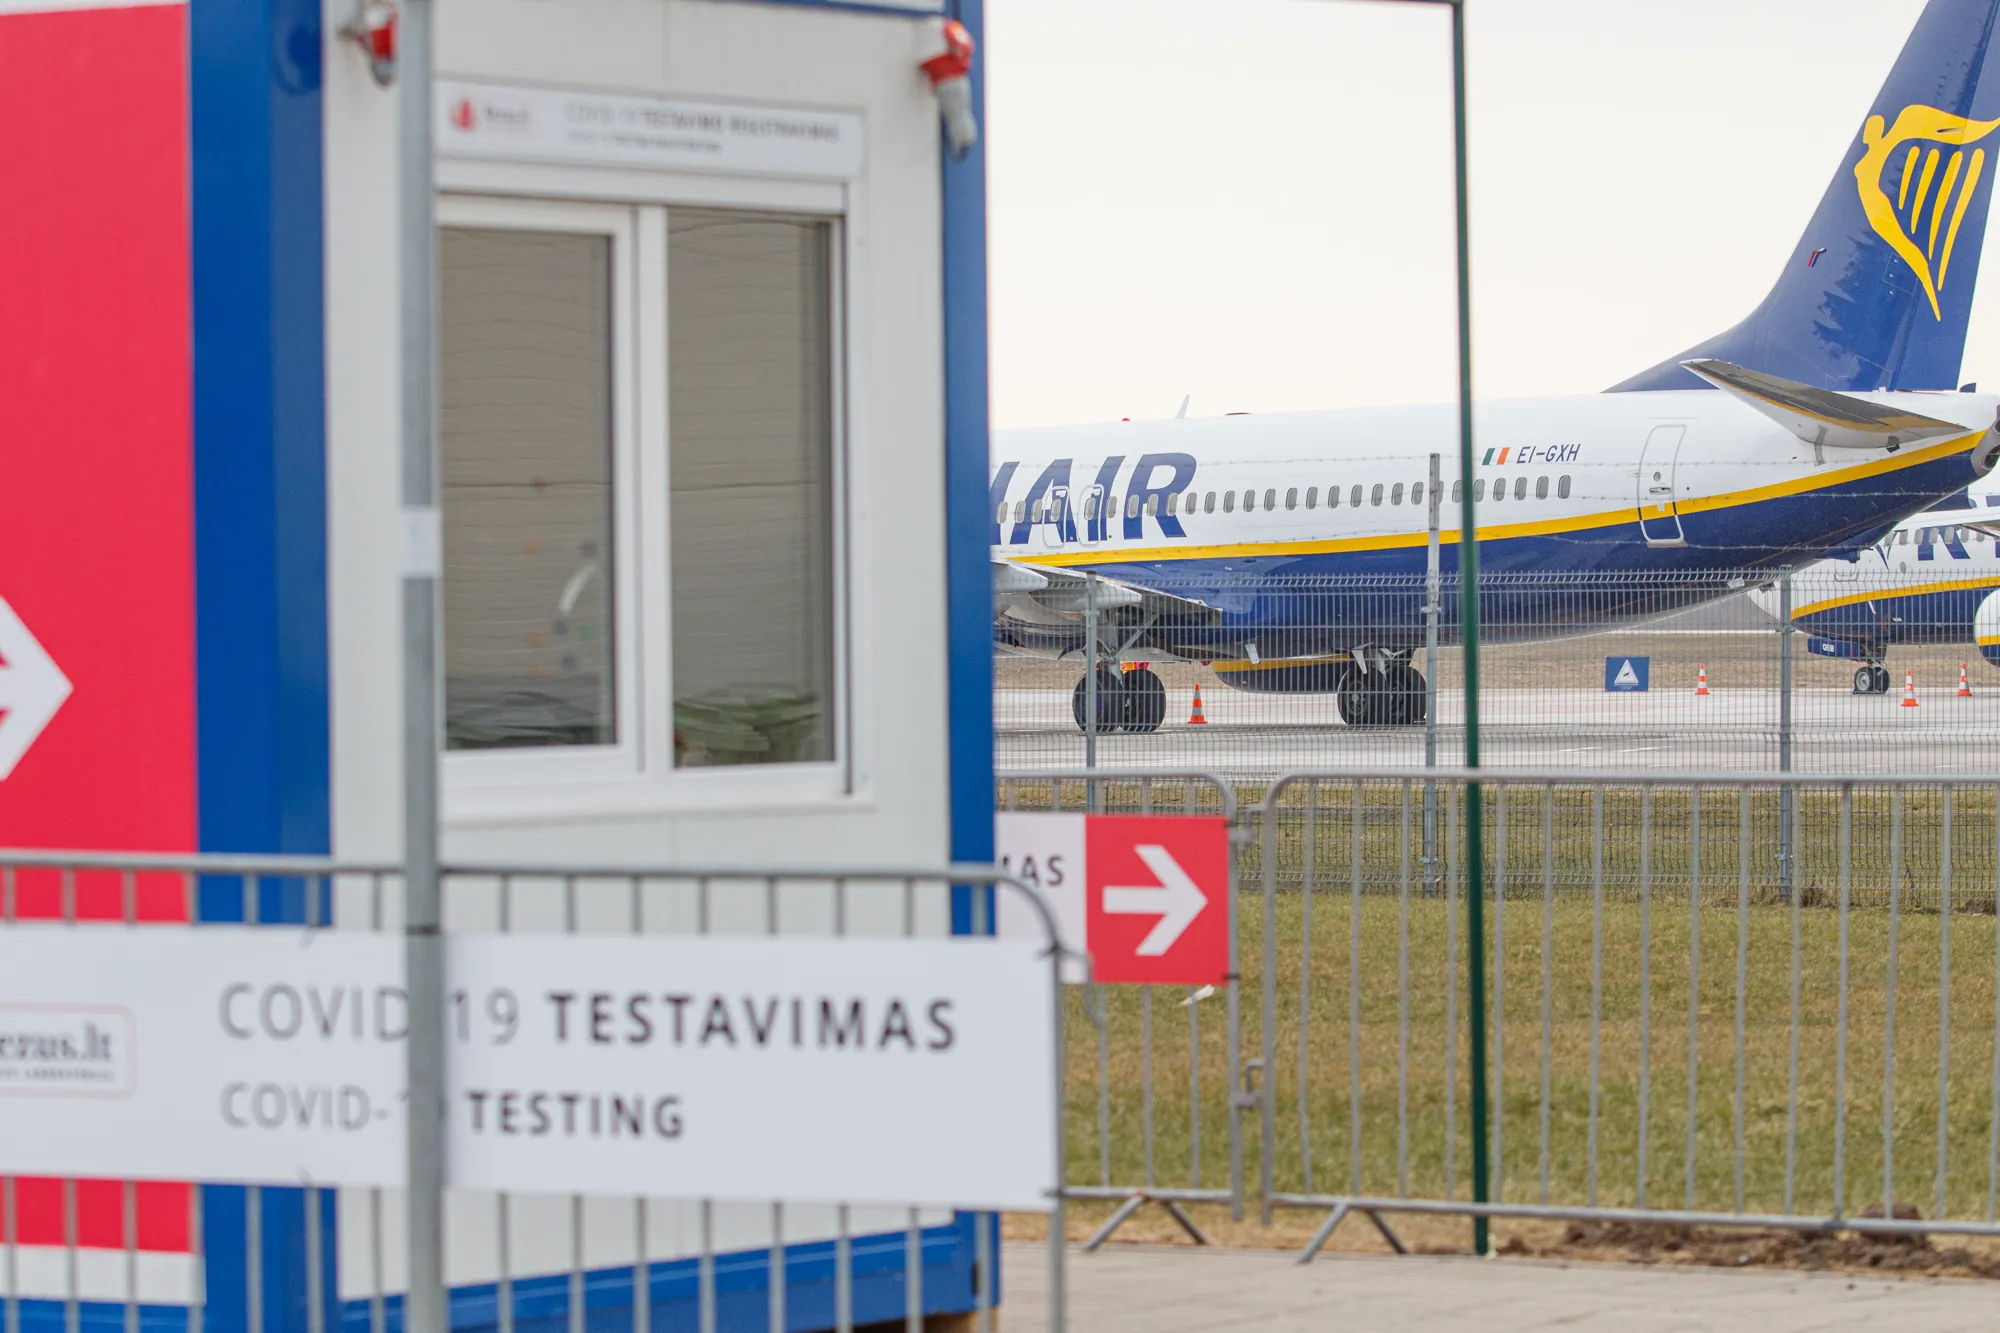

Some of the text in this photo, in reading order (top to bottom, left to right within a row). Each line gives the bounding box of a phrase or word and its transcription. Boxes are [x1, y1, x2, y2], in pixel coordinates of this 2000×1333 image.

[1516, 443, 1581, 464] EI-GXH
[1002, 855, 1064, 886] AS
[218, 981, 957, 1052] COVID19 TESTAVIMAS
[219, 1081, 686, 1138] COVID- TESTING
